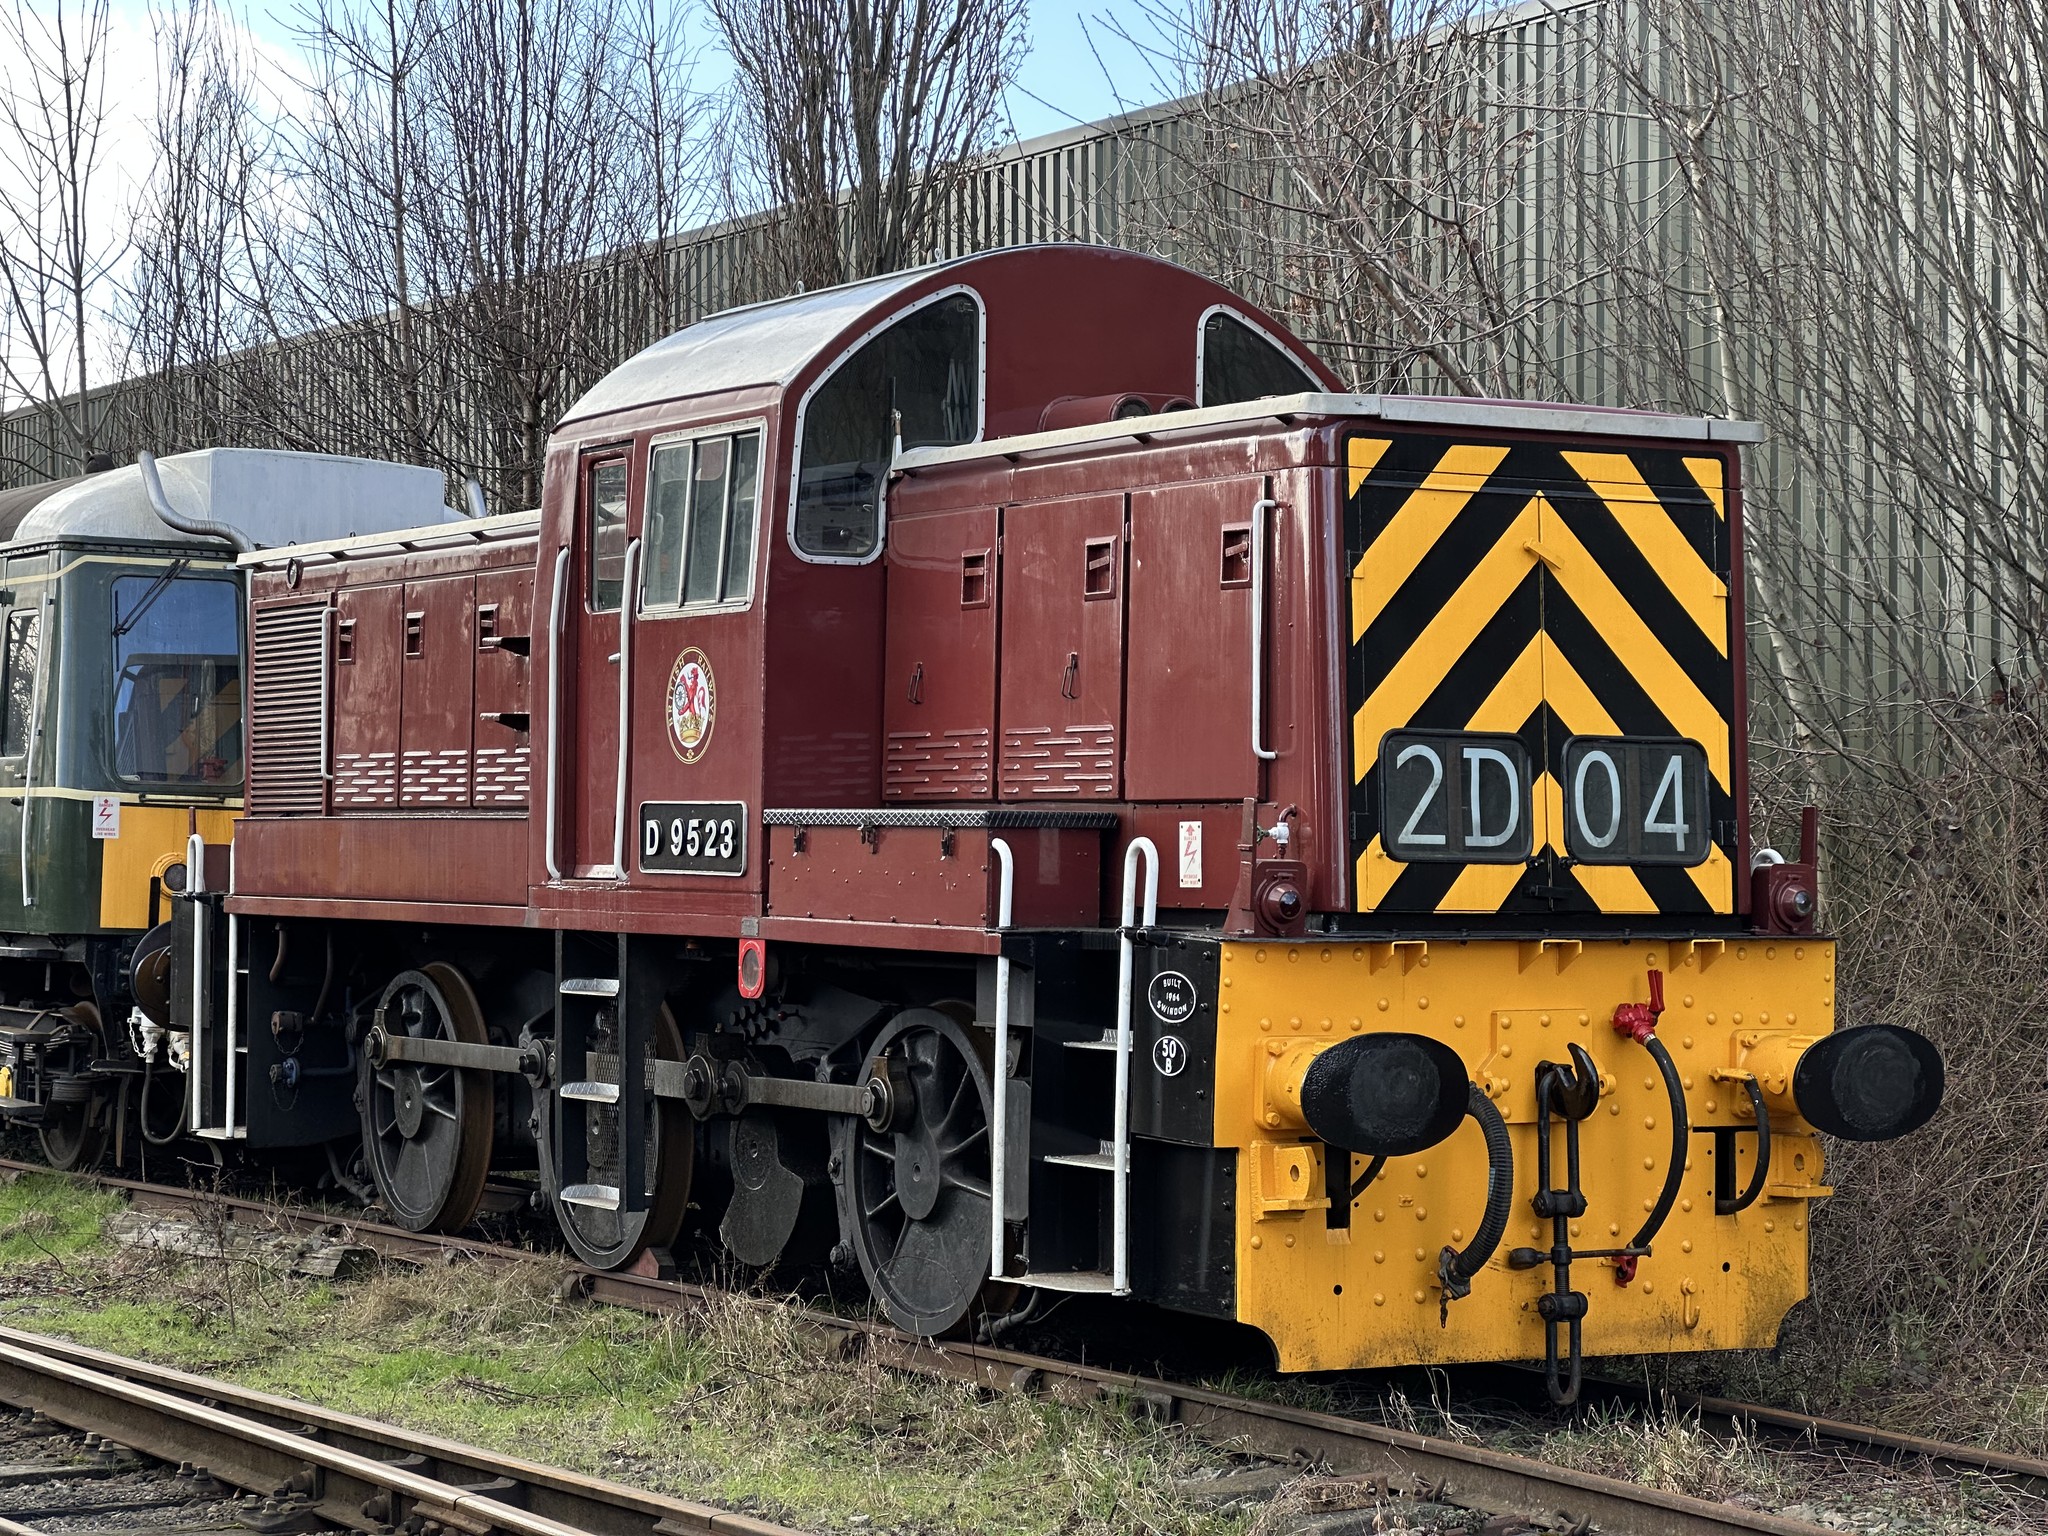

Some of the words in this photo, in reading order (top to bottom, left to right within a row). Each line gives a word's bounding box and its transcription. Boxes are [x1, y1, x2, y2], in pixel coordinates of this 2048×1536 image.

[668, 658, 685, 727] BRITISH
[697, 655, 714, 722] RAILWAYS
[645, 819, 663, 856] D
[670, 817, 737, 859] 9523
[1163, 978, 1182, 990] BUILT
[1166, 992, 1181, 1002] 1964
[1156, 1000, 1188, 1016] SWINDON
[1161, 1039, 1177, 1059] 50
[1165, 1058, 1173, 1074] B
